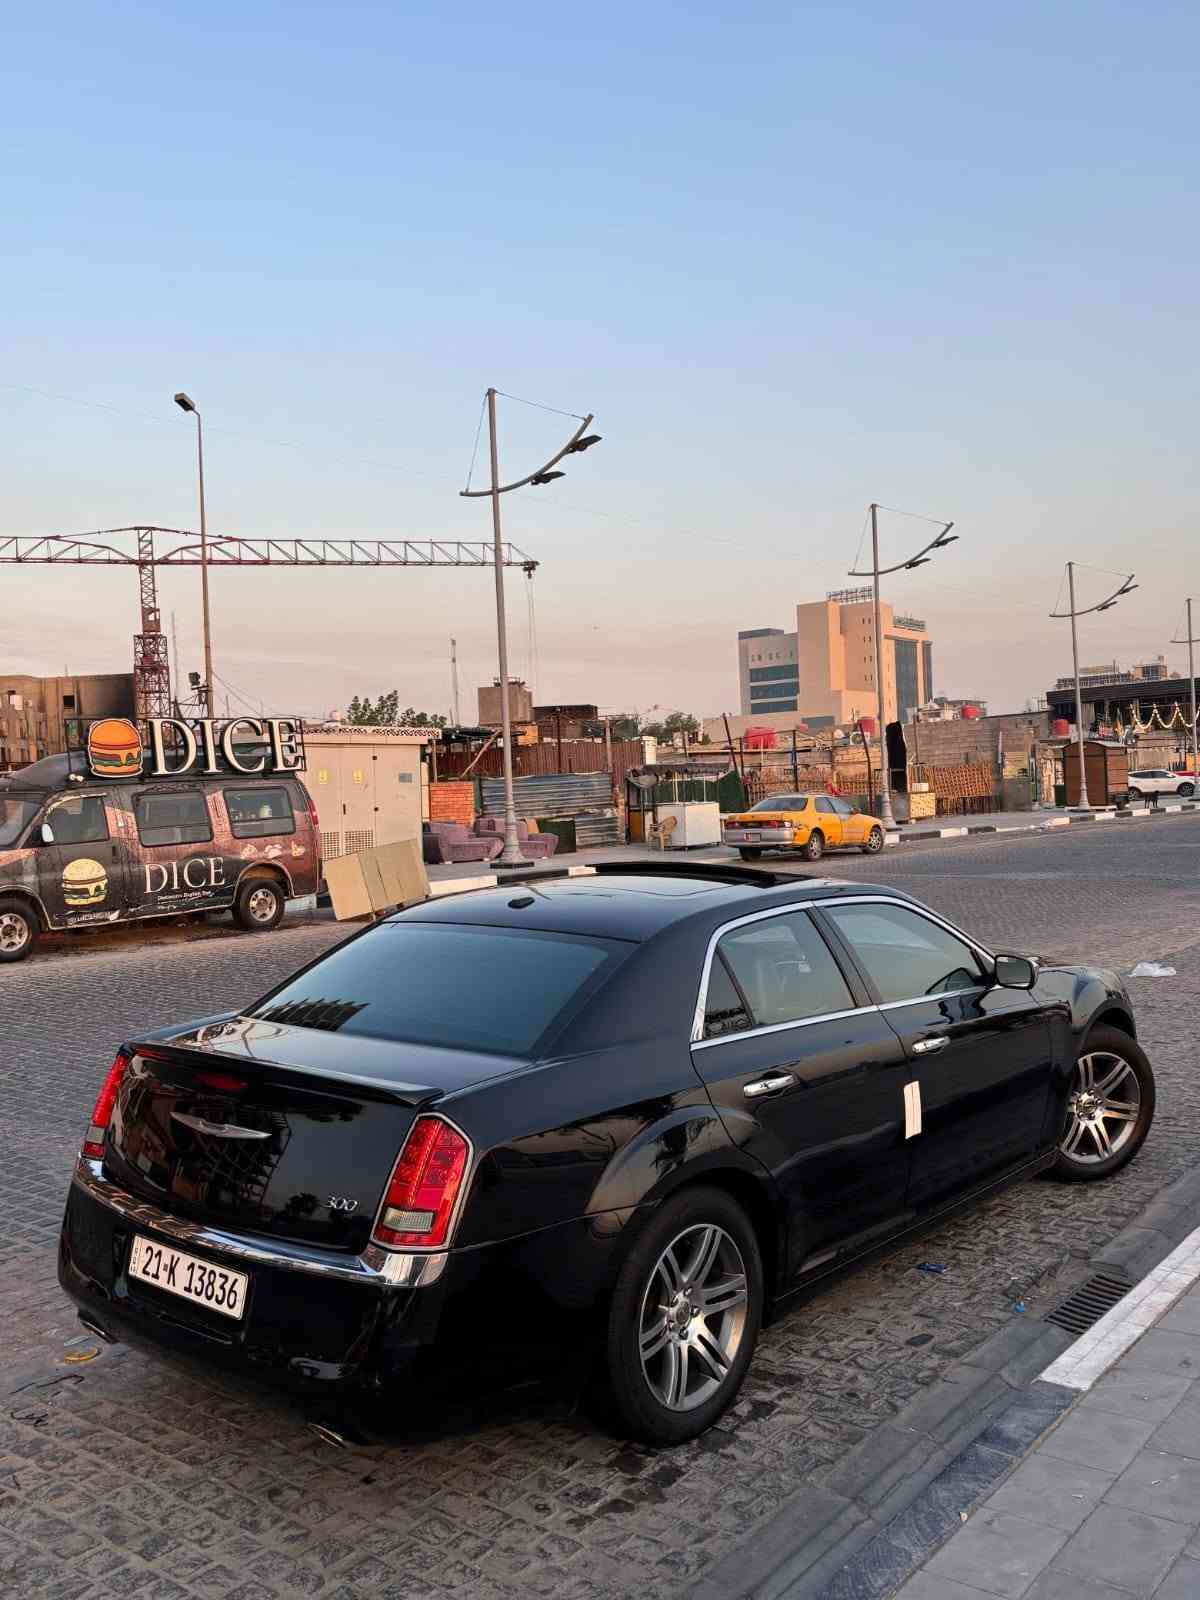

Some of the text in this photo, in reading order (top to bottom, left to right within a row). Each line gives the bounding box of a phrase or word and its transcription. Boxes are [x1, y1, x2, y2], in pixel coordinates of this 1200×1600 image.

[148, 717, 303, 775] DICE
[143, 856, 225, 894] DICE
[325, 1195, 358, 1211] 300
[183, 1261, 238, 1309] 13836
